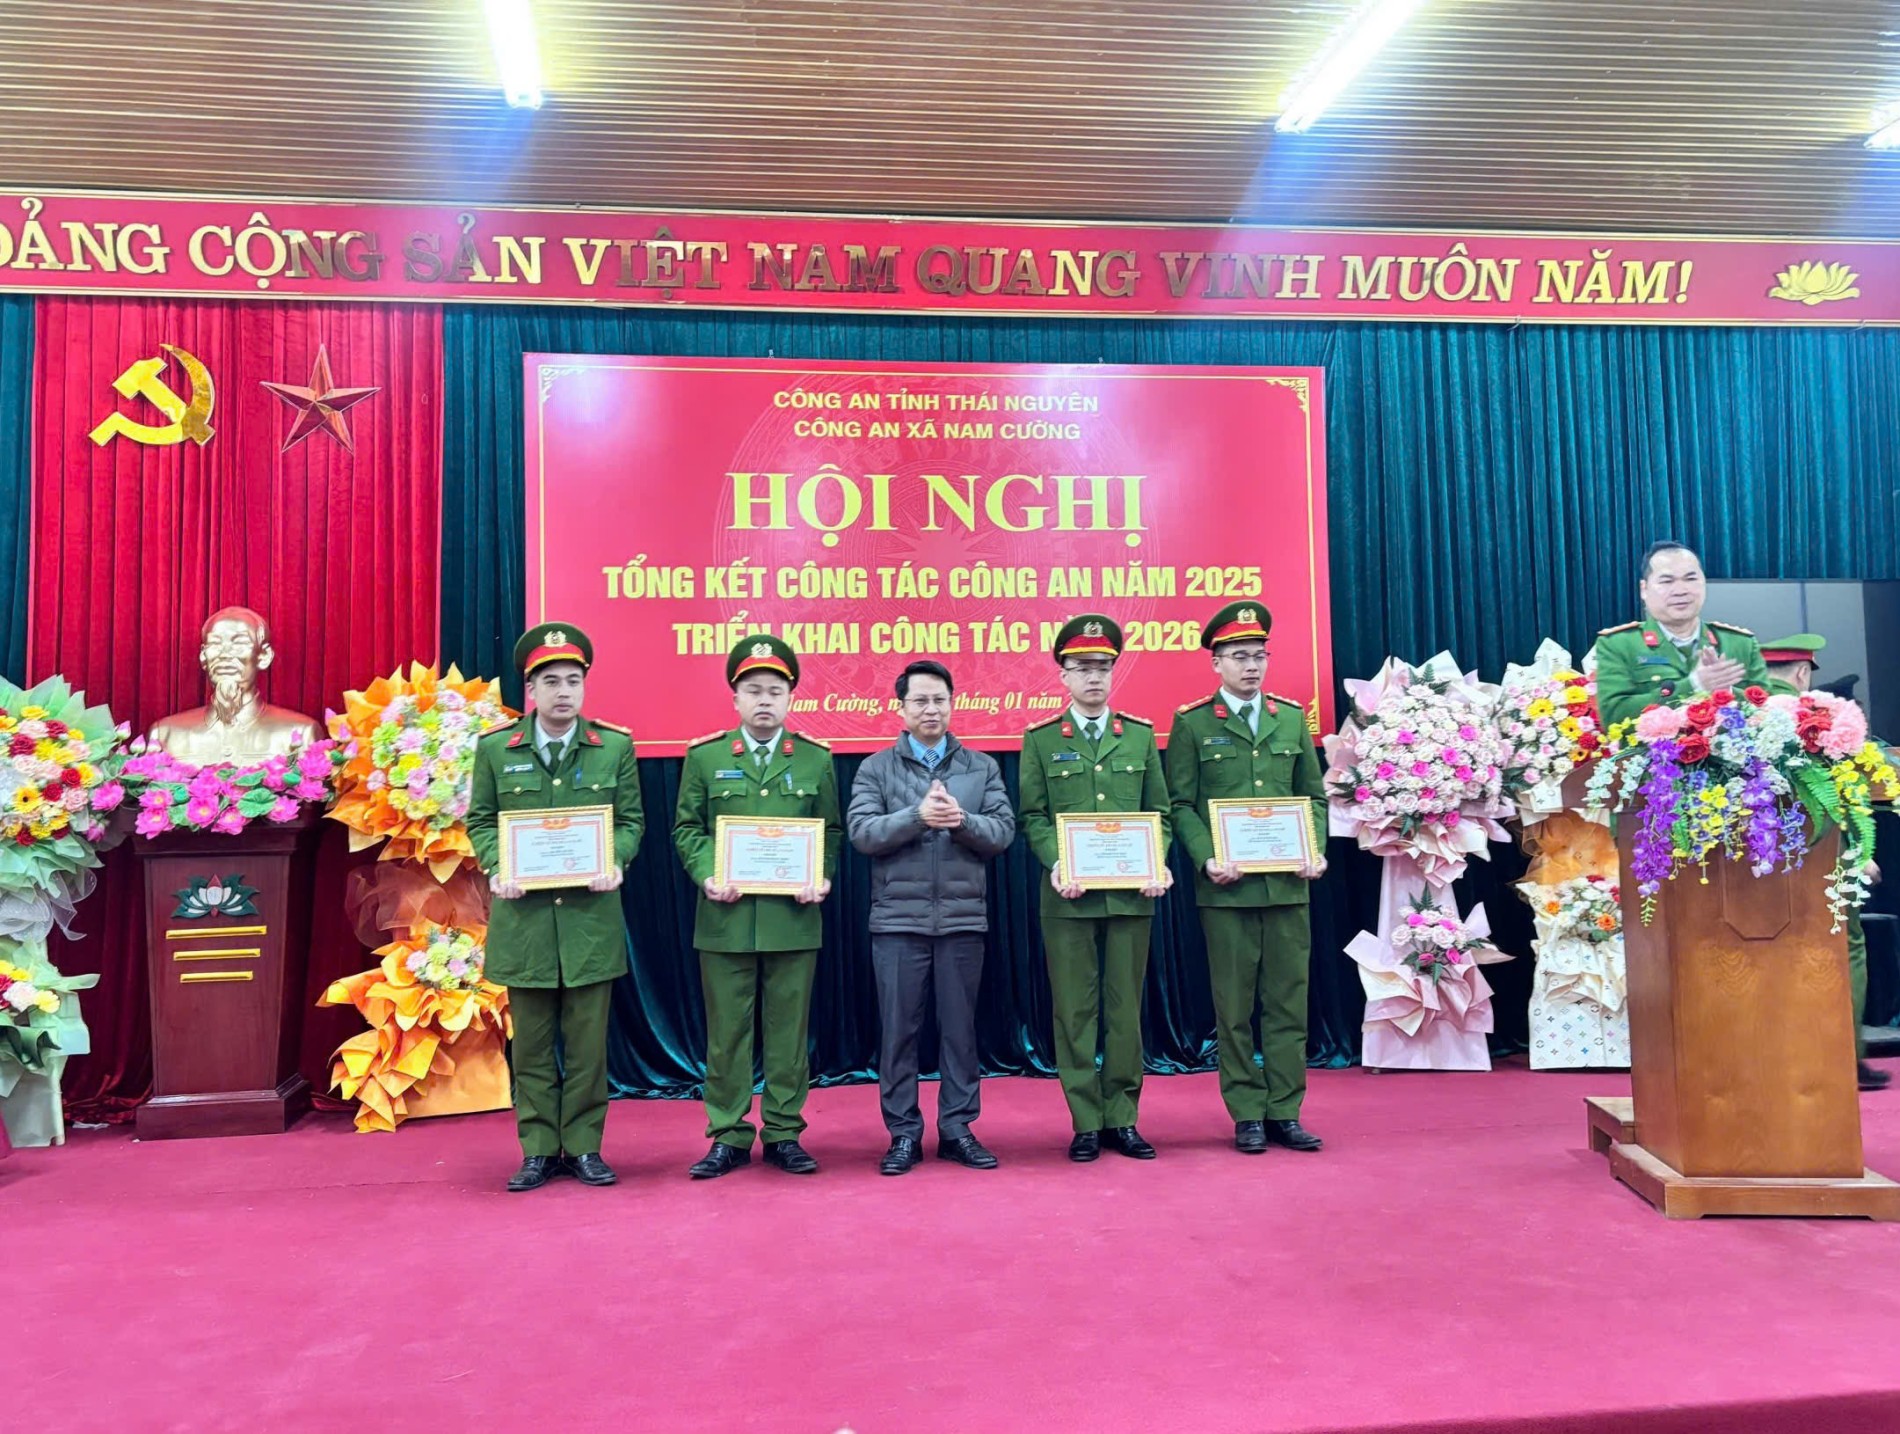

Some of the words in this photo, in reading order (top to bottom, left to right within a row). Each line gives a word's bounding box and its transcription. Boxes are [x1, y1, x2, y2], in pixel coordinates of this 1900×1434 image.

[188, 211, 383, 290] CỘNG
[402, 213, 543, 284] SẢN
[561, 226, 727, 299] VIỆT
[747, 242, 900, 293] NAM
[917, 243, 1141, 298] QUANG
[1159, 250, 1325, 299] VINH
[1337, 242, 1520, 302] MUÔN
[1531, 247, 1695, 305] NĂM!
[773, 388, 842, 409] CÔNG
[848, 393, 880, 410] AN
[886, 388, 940, 411] TỈNH
[946, 391, 998, 411] THÁI
[1004, 392, 1099, 412] NGUYÊN
[794, 417, 862, 438] CÔNG
[868, 422, 900, 438] AN
[906, 418, 938, 439] XÃ
[943, 423, 993, 439] NAM
[1000, 420, 1081, 440] CƯỜNG
[725, 463, 898, 548] HỘI
[919, 474, 1148, 548] NGHỊ
[602, 553, 695, 599] TỔNG
[704, 557, 767, 599] KẾT
[777, 561, 868, 599] CÔNG
[877, 561, 940, 599] TÁC
[949, 561, 1037, 598] CÔNG
[1047, 567, 1092, 597] AN
[1102, 560, 1176, 597] NĂM
[1185, 566, 1262, 597] 2025
[782, 622, 860, 655] KHAI
[870, 616, 960, 653] CÔNG
[969, 615, 1030, 652] TÁC
[1124, 621, 1201, 651] 2026
[954, 691, 999, 714] tháng
[1004, 691, 1022, 710] 01
[1027, 693, 1063, 709] năm
